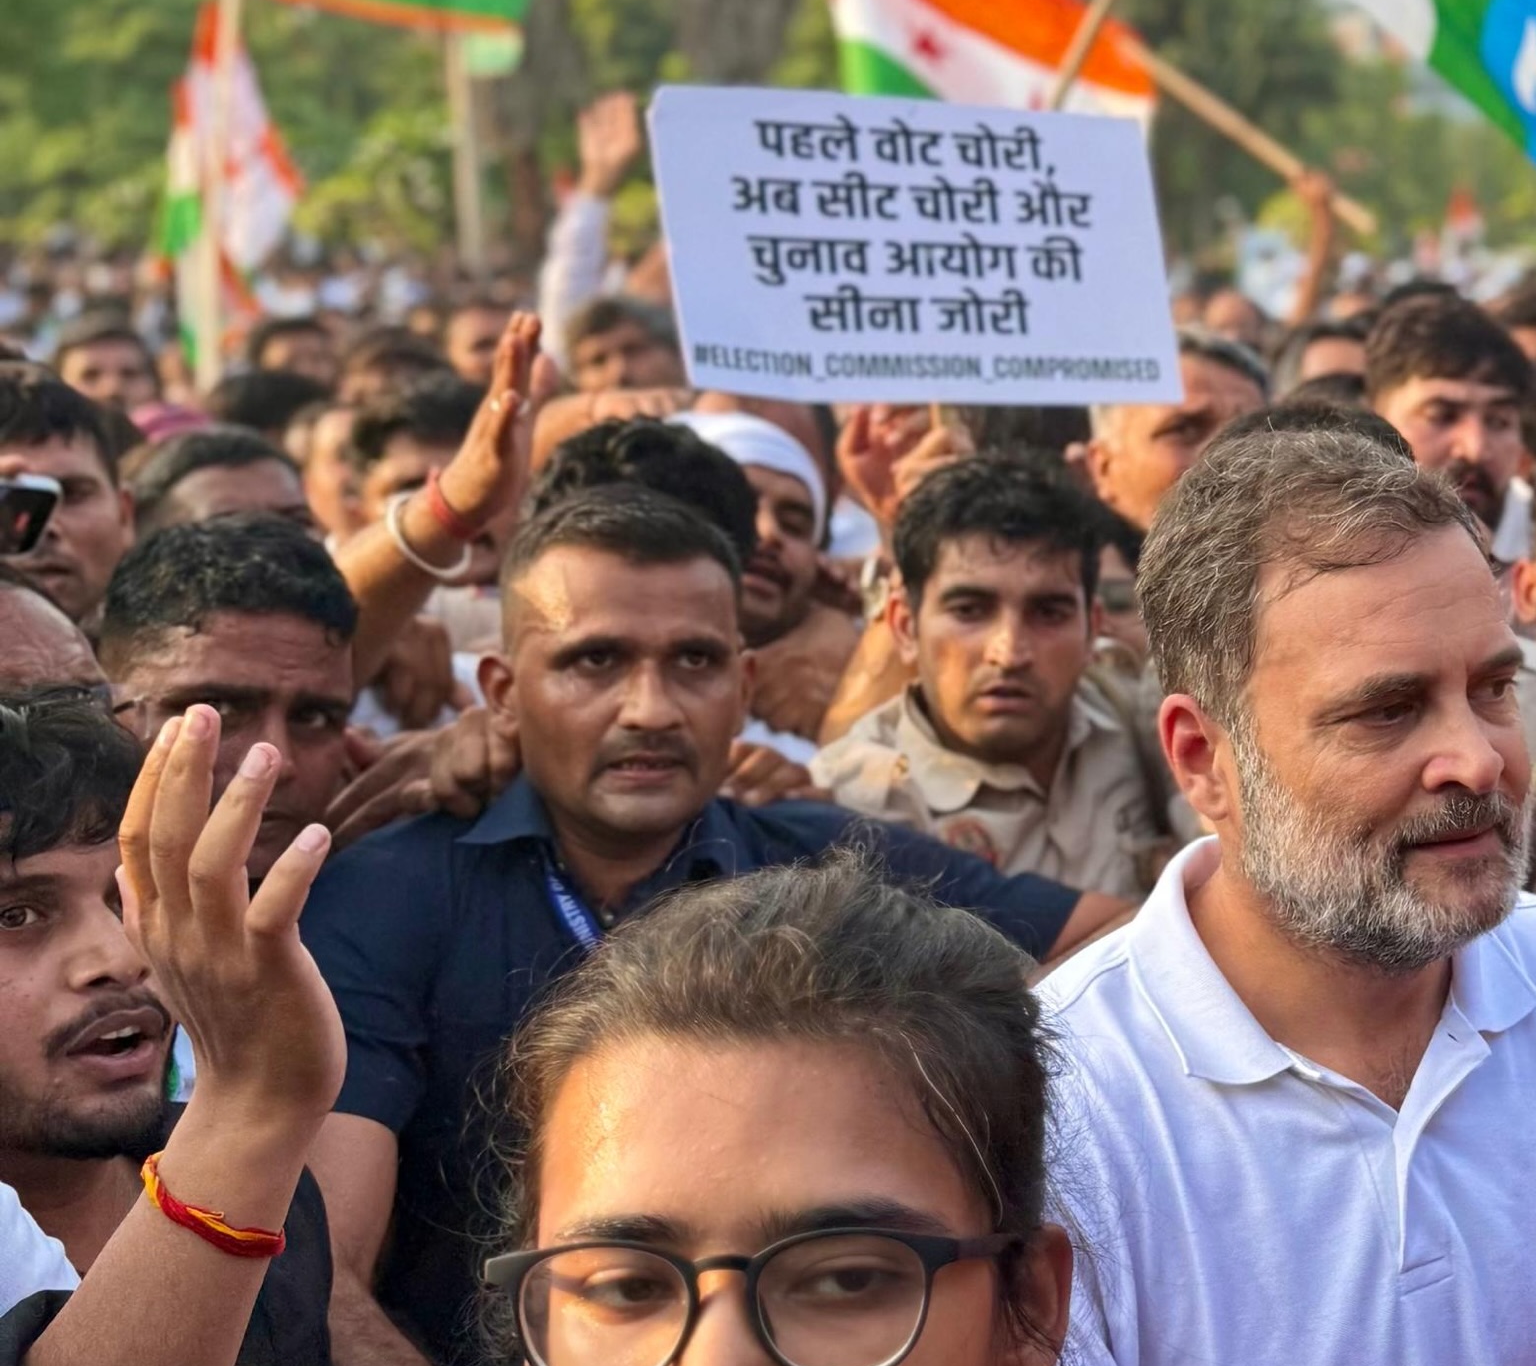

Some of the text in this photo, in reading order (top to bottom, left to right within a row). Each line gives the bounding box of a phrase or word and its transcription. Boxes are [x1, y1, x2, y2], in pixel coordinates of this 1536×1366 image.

[753, 113, 1056, 178] पहले वोट चोरी,
[731, 170, 1092, 229] अब सीट चोरी और
[746, 231, 1083, 287] चुनाव आयोग की
[803, 283, 1029, 335] सीना जोरी
[694, 343, 1160, 382] #ELECTION_COMMISSION_COMPROMISED
[557, 894, 599, 952] INISTRY
